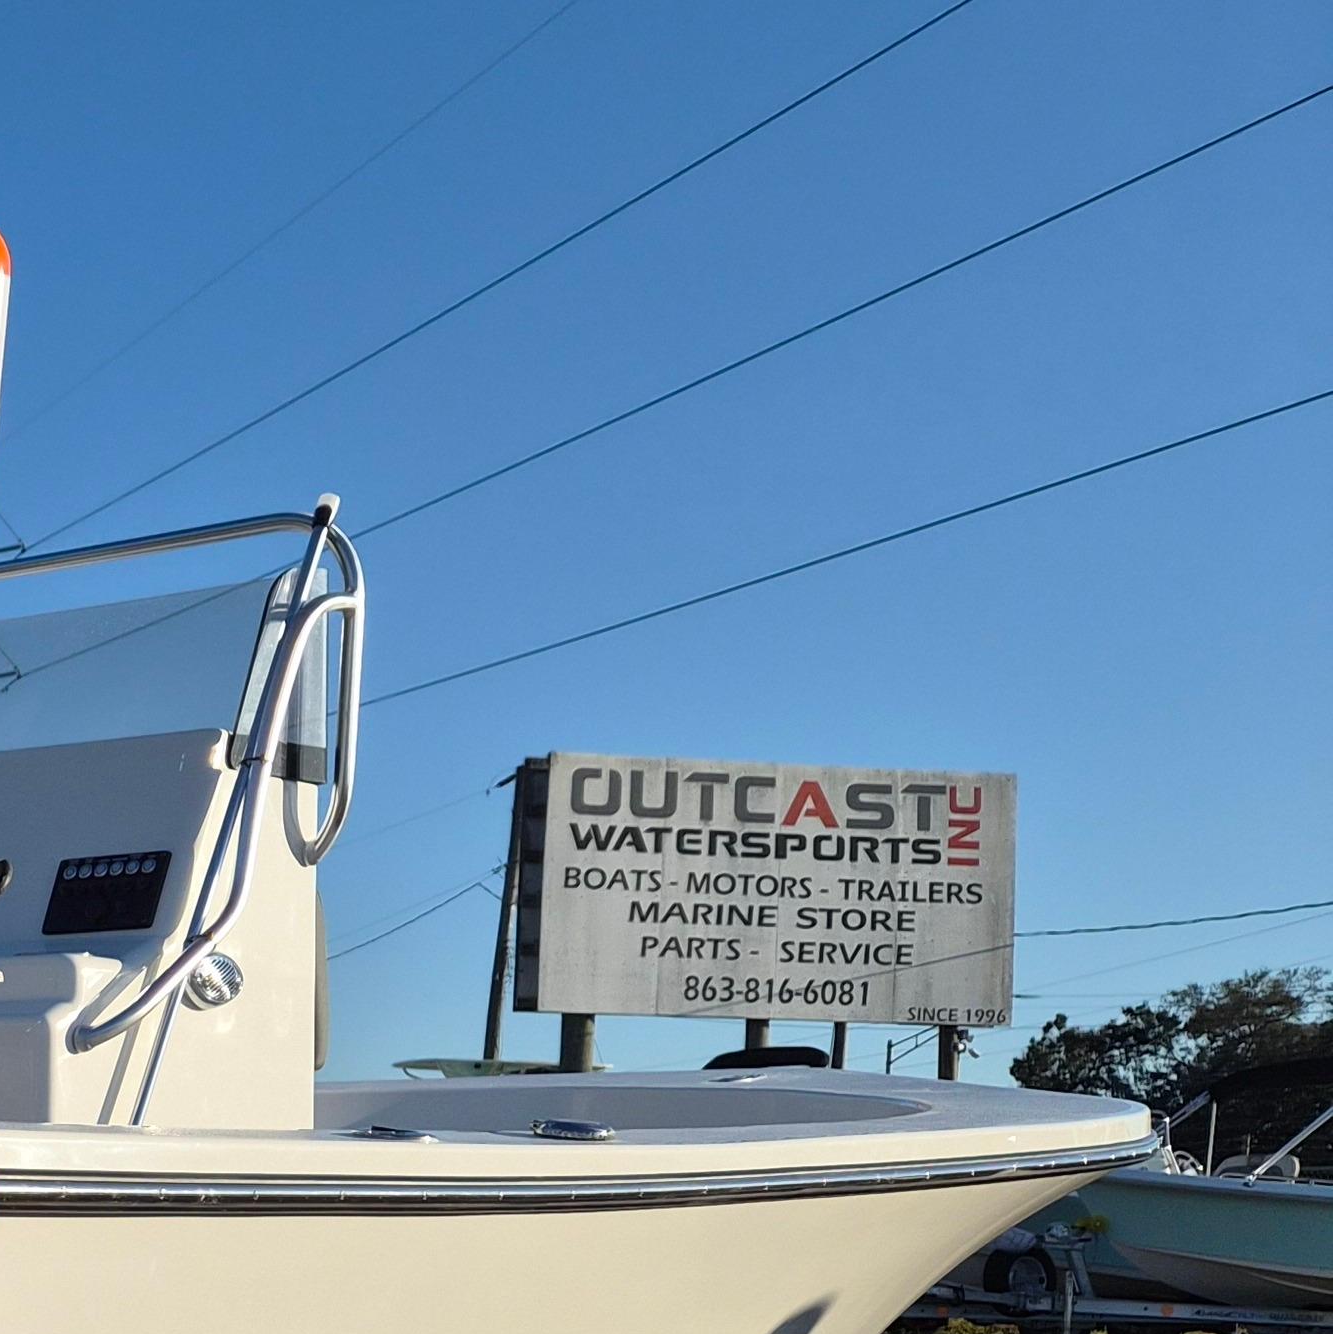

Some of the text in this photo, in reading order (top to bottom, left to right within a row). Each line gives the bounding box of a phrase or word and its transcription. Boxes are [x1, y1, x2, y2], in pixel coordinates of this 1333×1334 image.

[570, 767, 947, 832] OUTCAST
[569, 822, 942, 865] WATERSPORTS
[947, 785, 982, 867] INC
[563, 866, 662, 893] BOATS
[685, 871, 813, 899] MOTORS
[838, 878, 983, 905] TRAILERS
[628, 900, 916, 932] MARINE STORE
[640, 935, 741, 961] PARTS
[779, 940, 914, 966] SERVICE
[683, 975, 870, 1006] 863-816-6081
[907, 1006, 1007, 1024] SINCE 1996
